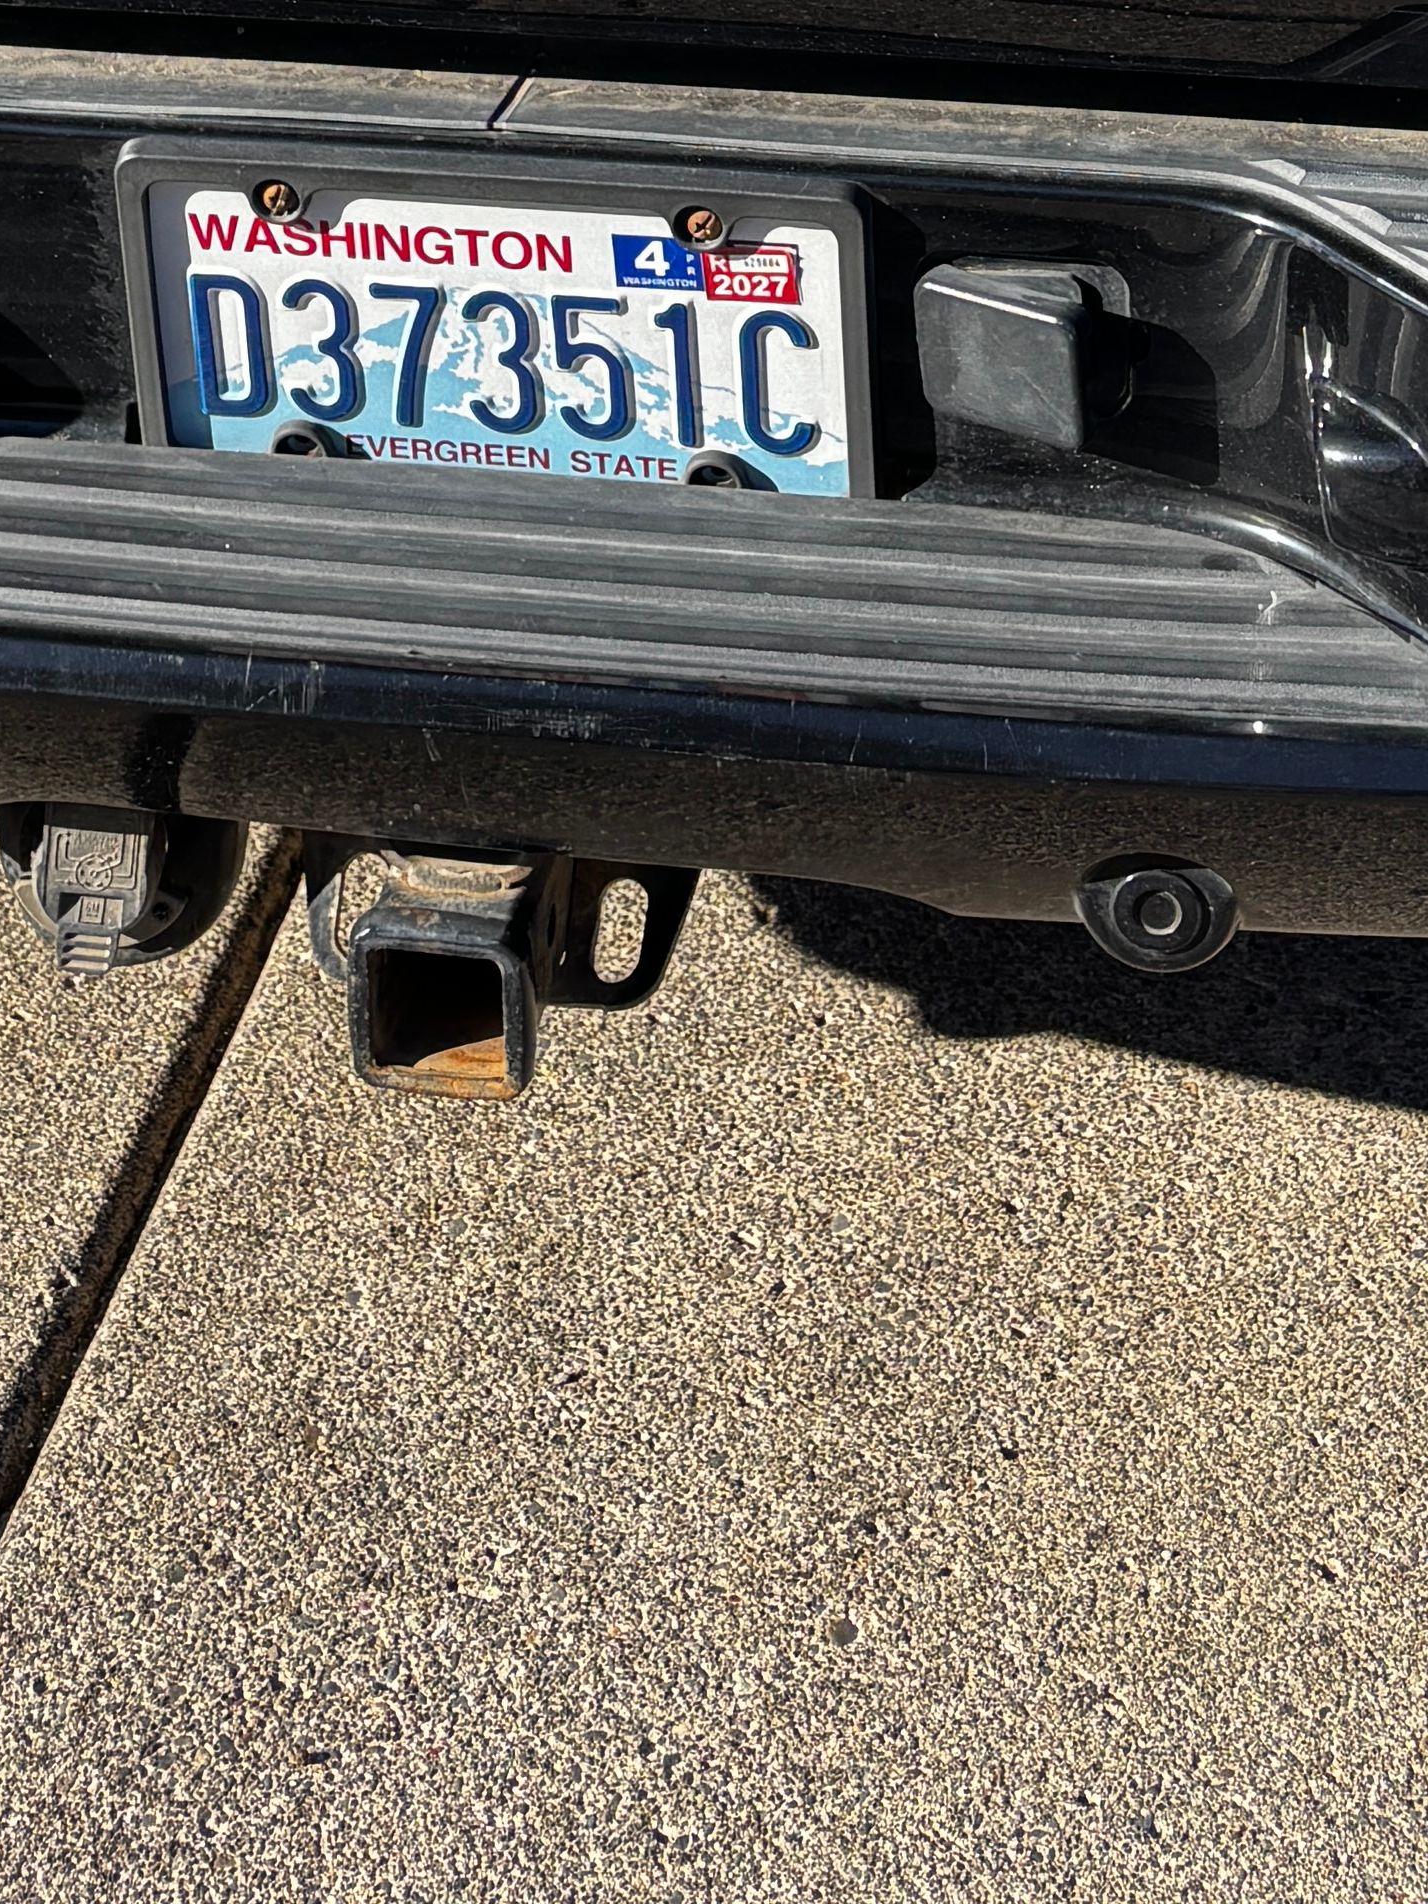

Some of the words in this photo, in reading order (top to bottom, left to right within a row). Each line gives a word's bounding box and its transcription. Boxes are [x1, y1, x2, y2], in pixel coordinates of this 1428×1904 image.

[188, 212, 573, 273] WASHINGTON
[634, 240, 670, 277] 4
[623, 276, 697, 289] WASHINGTON
[713, 274, 788, 298] 2027
[190, 273, 816, 457] D37351C
[345, 434, 550, 470] EVERGREEN
[571, 449, 679, 481] STATE
